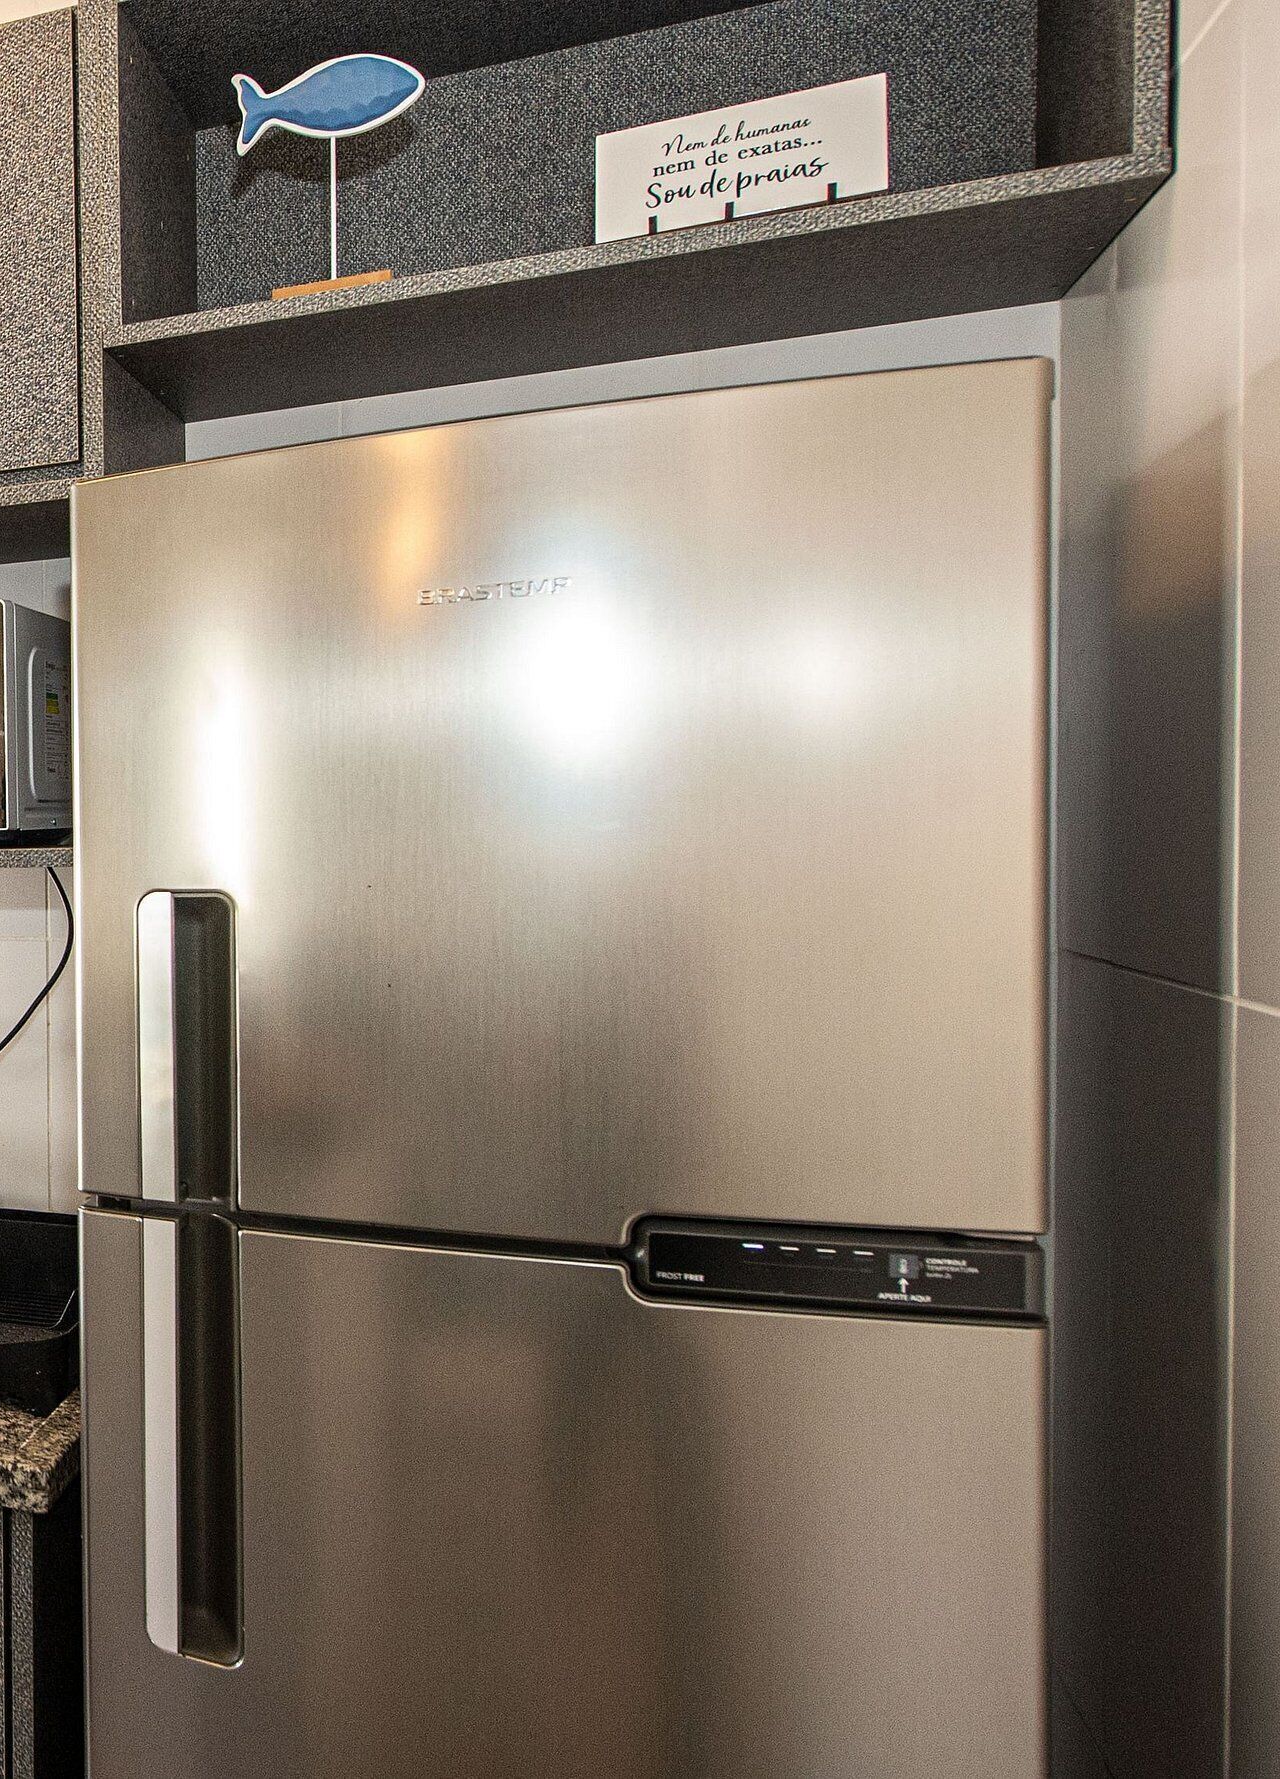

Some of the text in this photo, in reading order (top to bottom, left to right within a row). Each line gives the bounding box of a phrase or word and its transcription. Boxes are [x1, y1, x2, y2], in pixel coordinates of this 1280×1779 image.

[662, 118, 812, 157] Nem de humanas
[653, 137, 823, 178] nem de exatas...
[645, 156, 830, 209] Sou de praias
[417, 576, 571, 606] BRASTEMP
[656, 1271, 681, 1280] FROST
